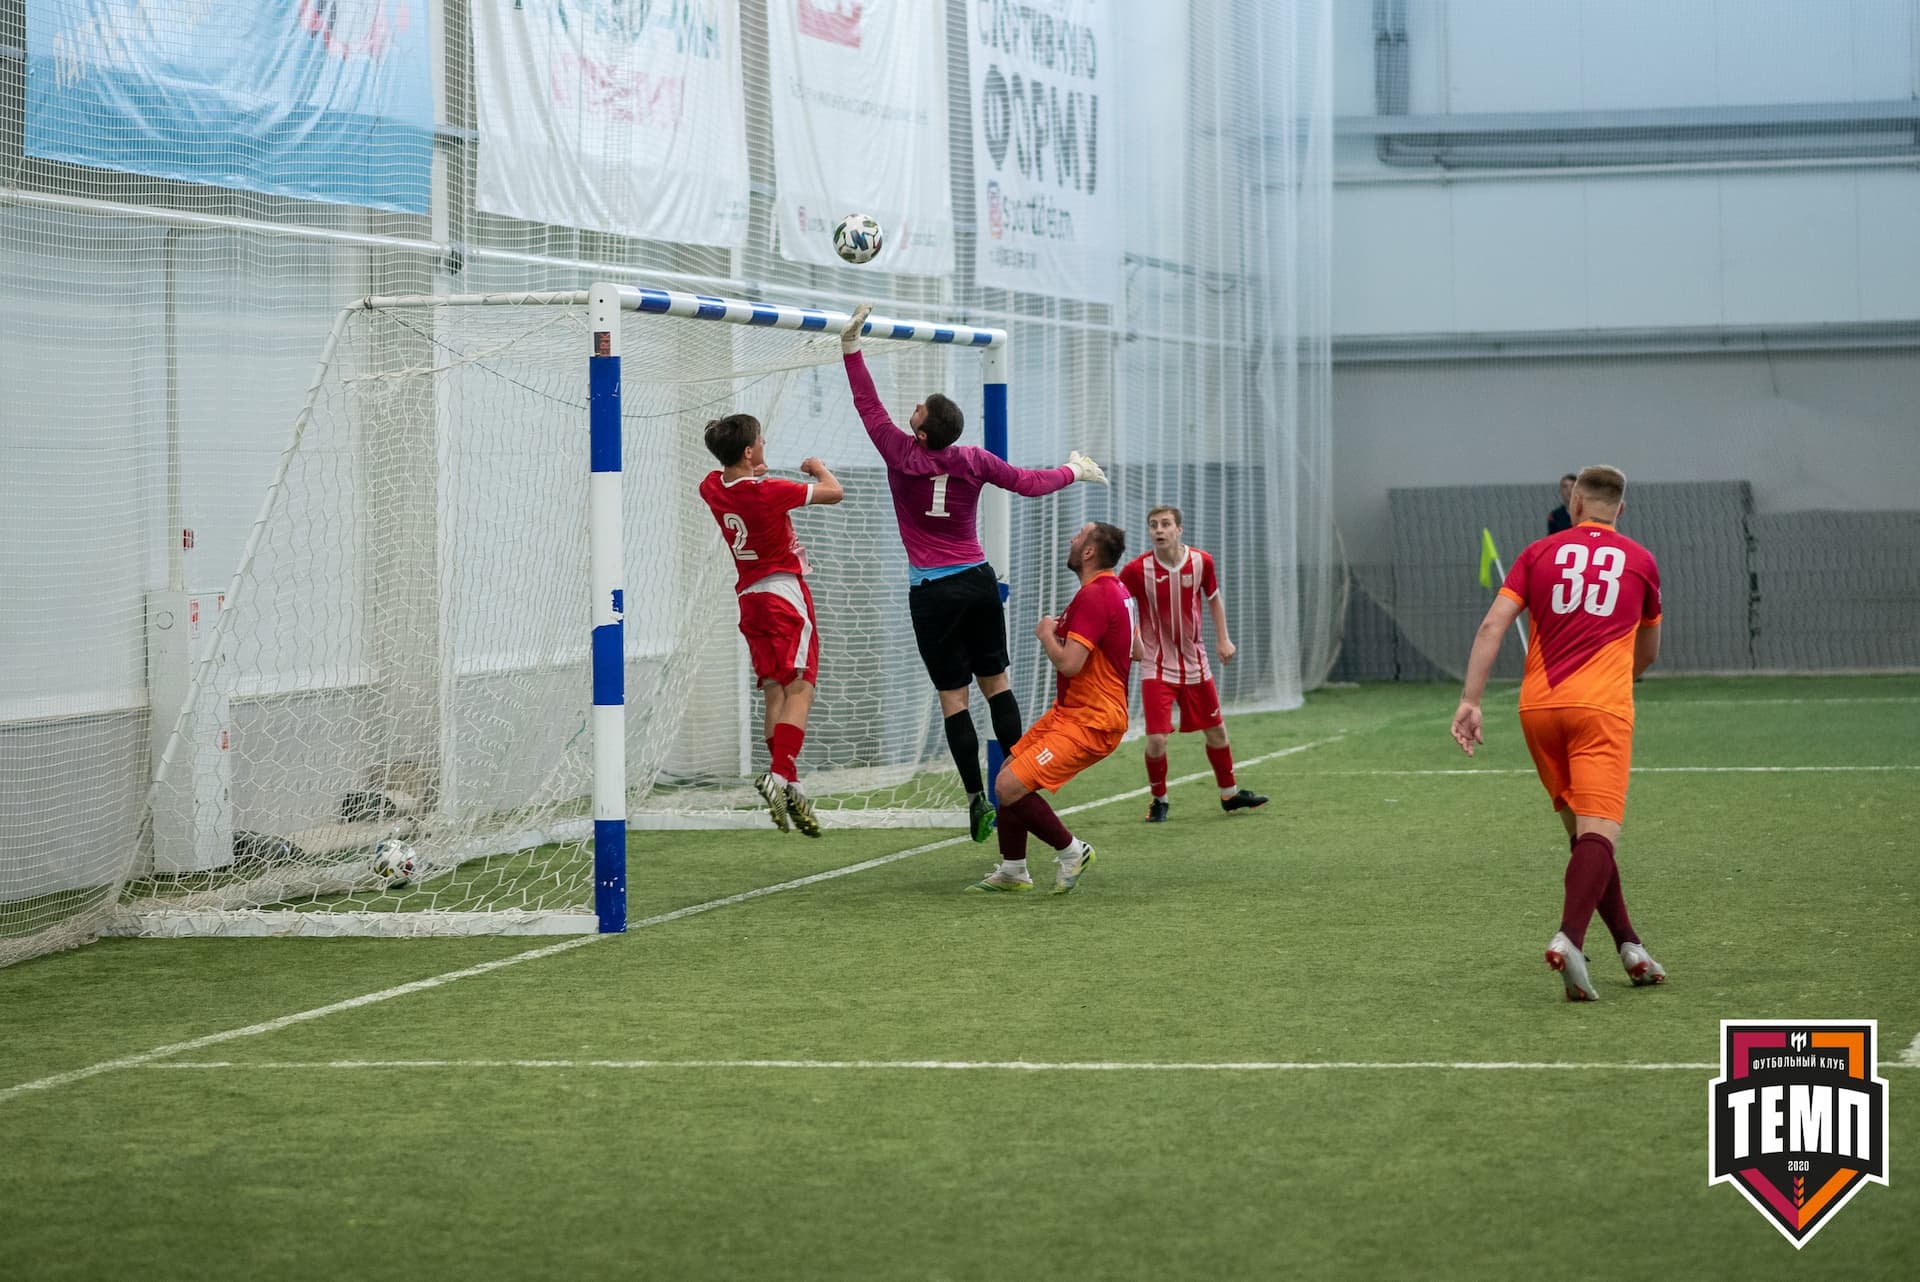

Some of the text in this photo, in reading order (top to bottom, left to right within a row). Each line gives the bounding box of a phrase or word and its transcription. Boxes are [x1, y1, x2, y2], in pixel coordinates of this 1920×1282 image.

[983, 63, 1098, 194] ФОРМУ
[925, 473, 951, 518] 1
[723, 513, 759, 561] 2
[1551, 543, 1626, 617] 33
[1035, 747, 1054, 766] 10
